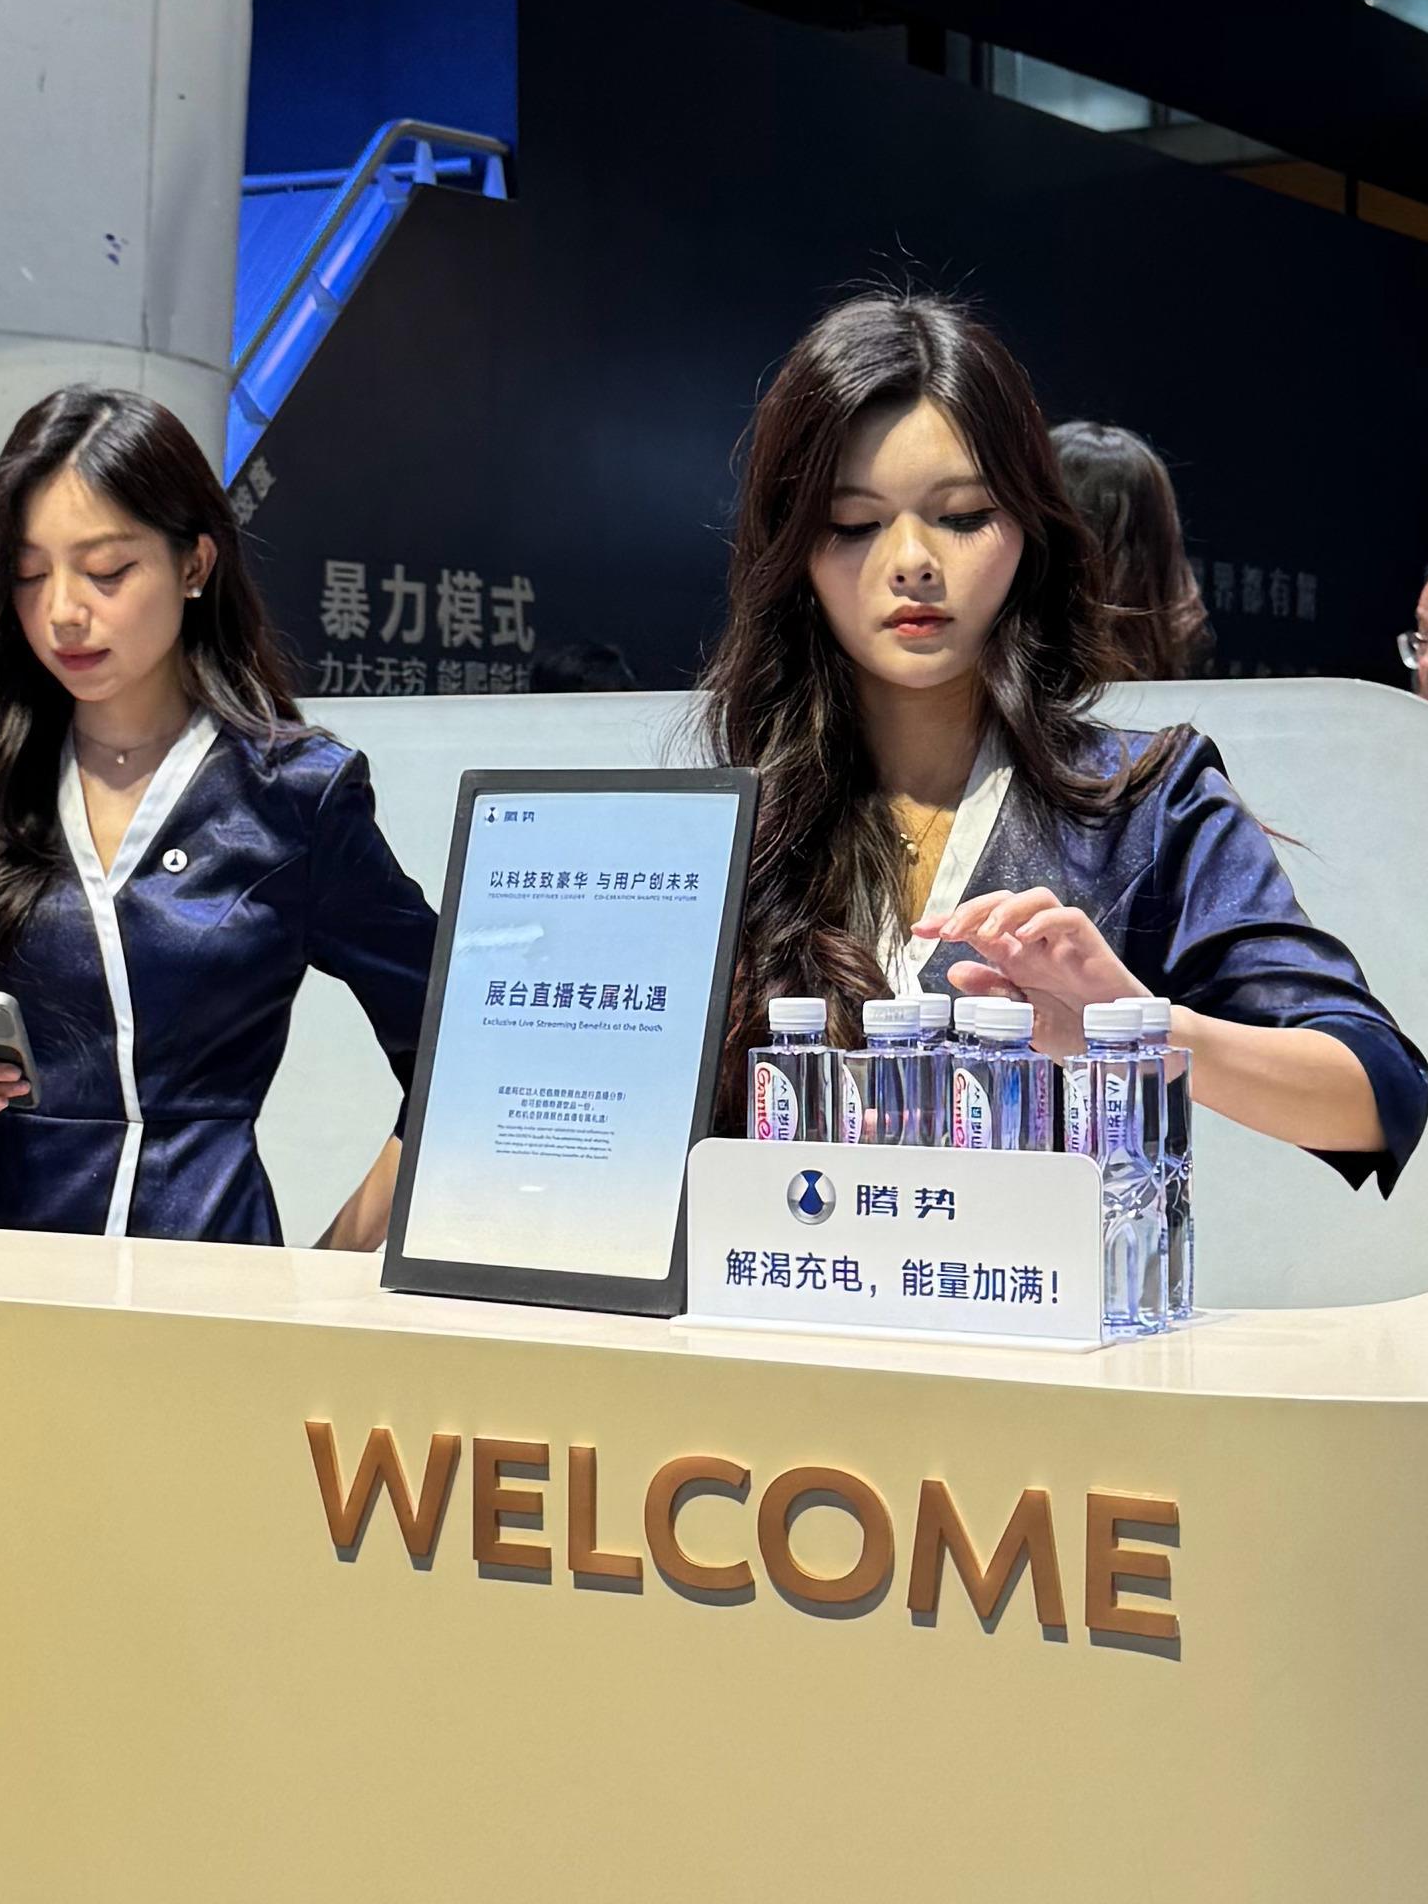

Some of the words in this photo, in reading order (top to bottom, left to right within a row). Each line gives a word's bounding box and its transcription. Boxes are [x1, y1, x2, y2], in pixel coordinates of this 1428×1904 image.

[319, 559, 537, 654] 暴力模式
[319, 652, 427, 695] 力大无穷
[489, 870, 589, 890] 以科技致豪华
[596, 871, 701, 891] 与用户创未来
[484, 980, 668, 1012] 展台直播专属礼遇
[518, 1018, 534, 1027] Live
[536, 1019, 577, 1031] Streaming
[757, 1067, 771, 1140] Gante
[855, 1184, 956, 1221] 腾势
[725, 1247, 1060, 1305] 解渴充电，能量加满！
[303, 1419, 1181, 1644] WELCOME
